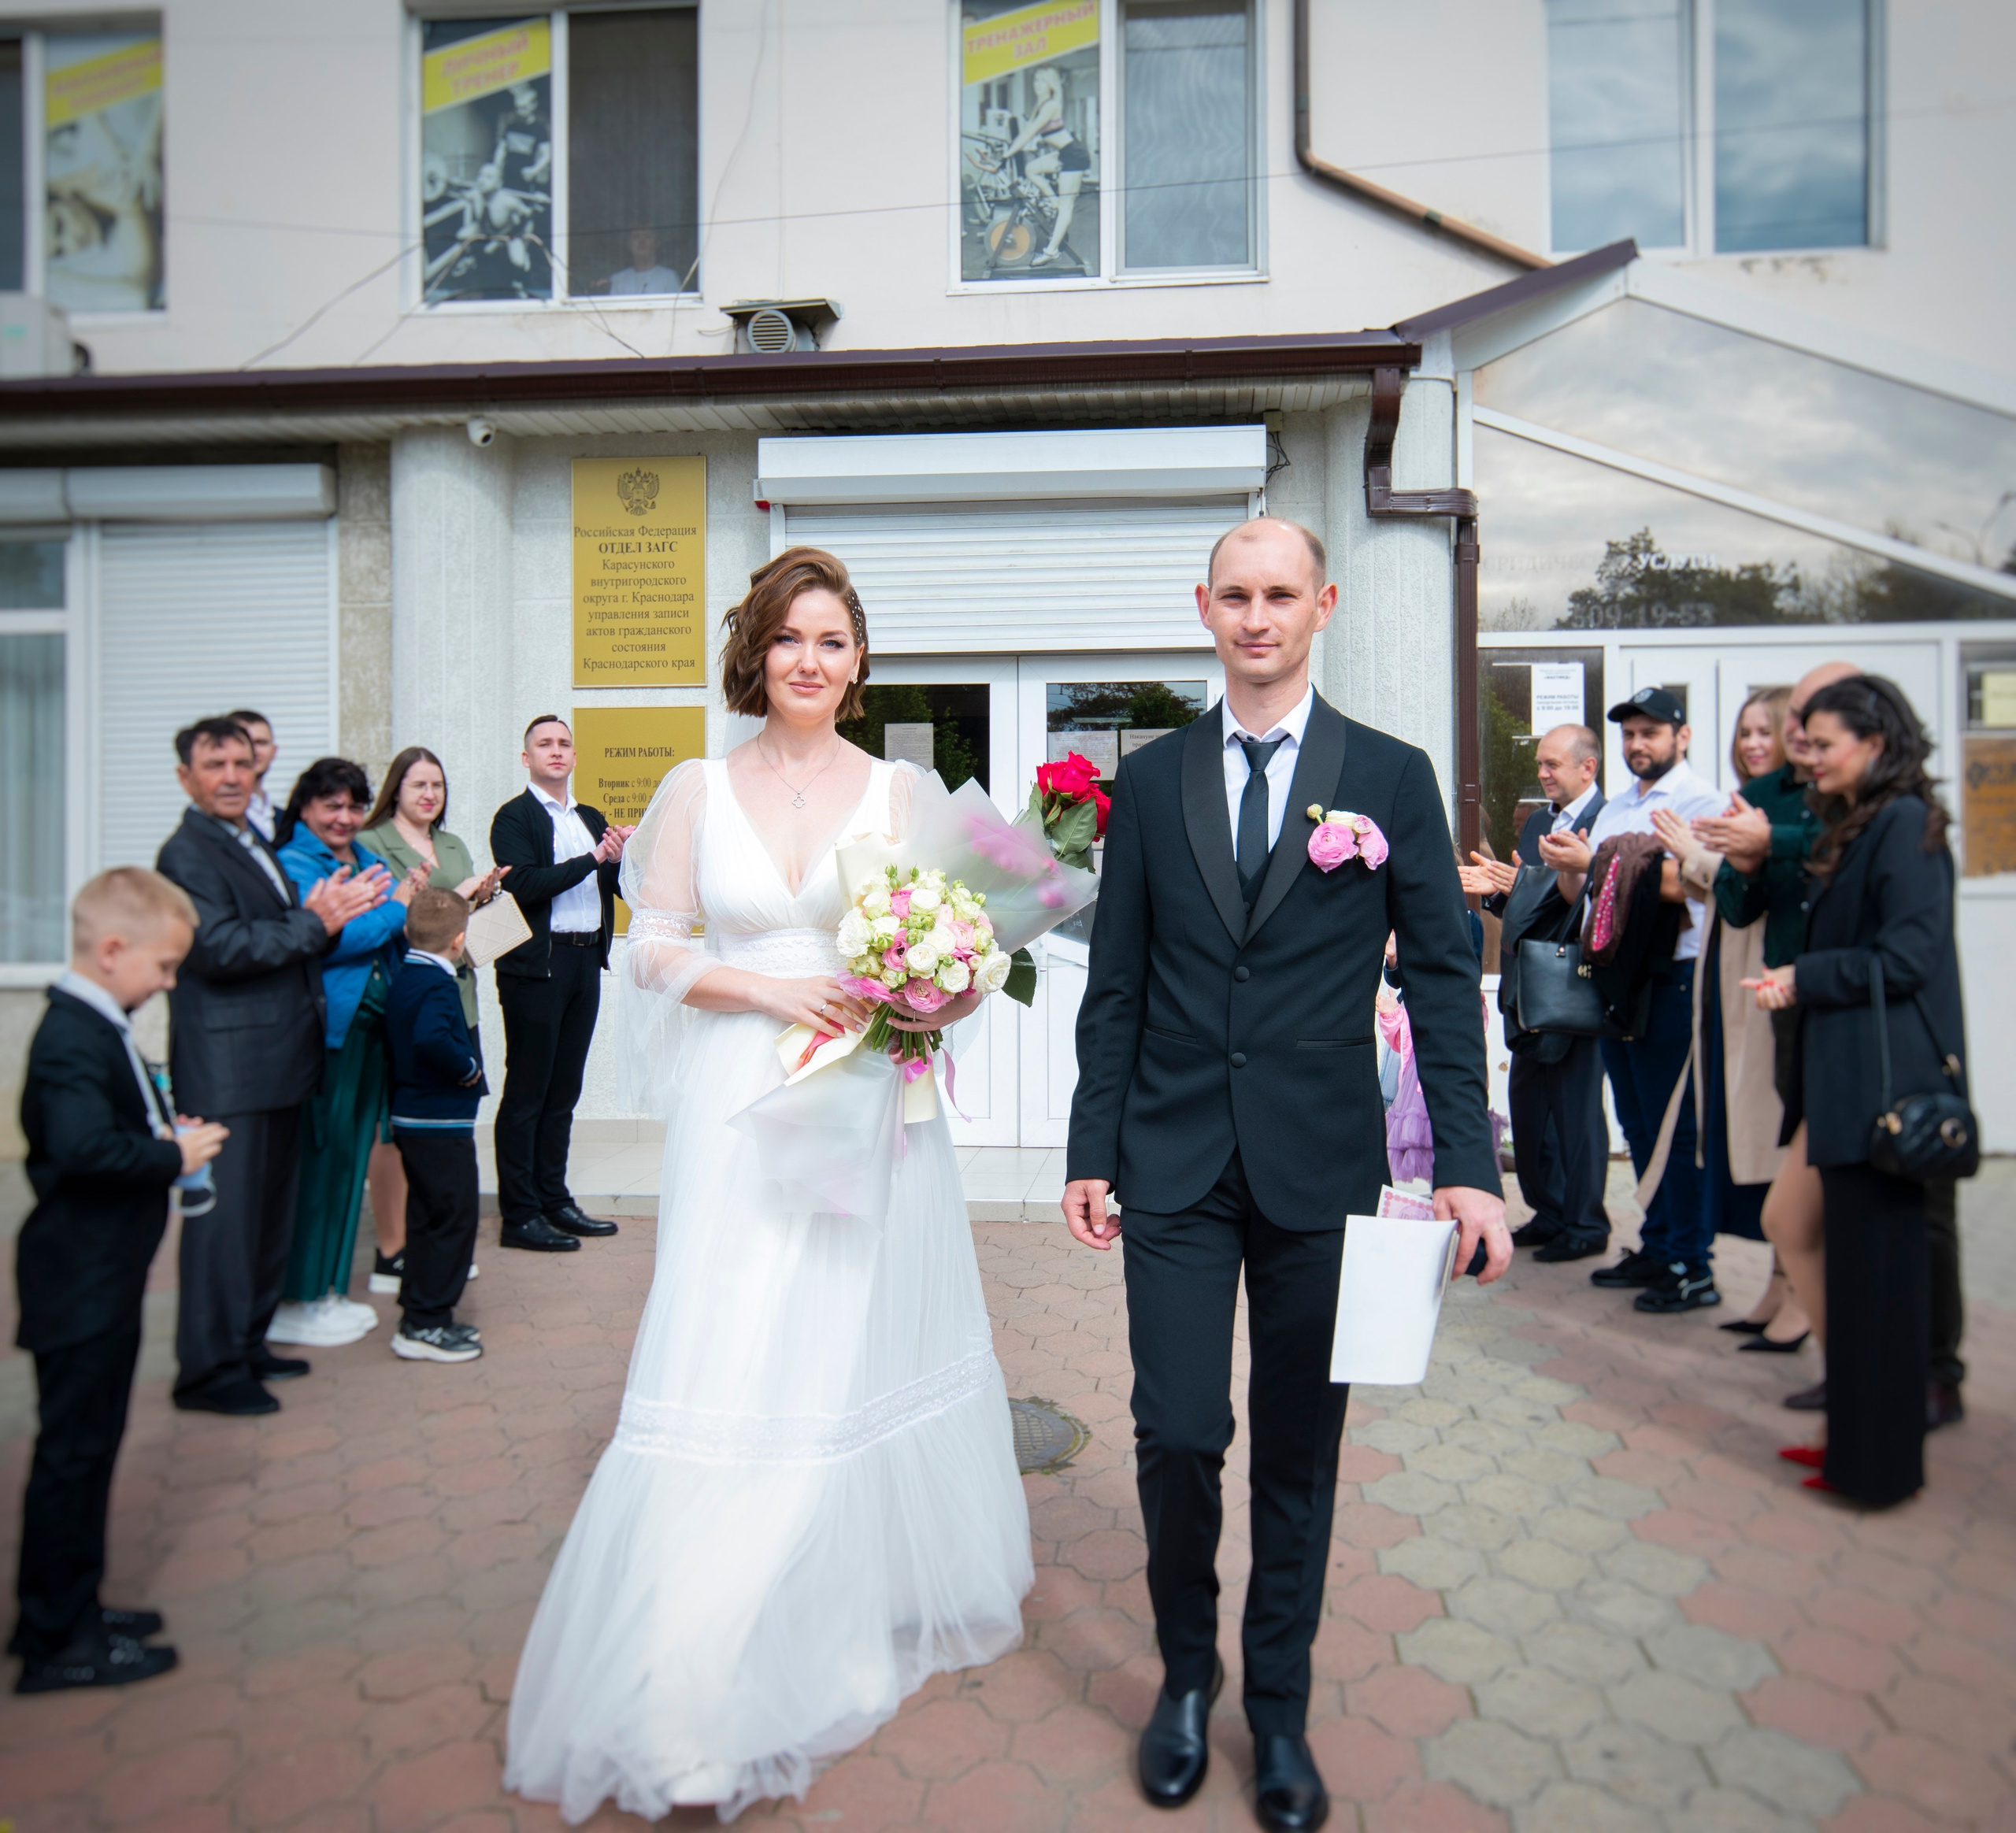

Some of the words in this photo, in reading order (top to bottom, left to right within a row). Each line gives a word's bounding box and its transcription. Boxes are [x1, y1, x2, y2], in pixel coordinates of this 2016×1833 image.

[1014, 35, 1047, 59] ЗАЛ
[574, 527, 635, 538] Российская
[638, 526, 697, 539] Федерация
[598, 542, 641, 554] ОТДЕЛ
[646, 541, 678, 553] ЗАГС
[602, 559, 675, 572] Карасунского
[591, 577, 687, 589] внутригородского
[583, 594, 618, 605] округа
[632, 591, 695, 605] Краснодара
[588, 611, 650, 622] управления
[653, 610, 689, 619] записи
[619, 626, 691, 639] гражданского
[612, 643, 665, 652] состояния
[584, 658, 668, 672] Краснодарского
[672, 659, 695, 670] края
[605, 747, 636, 757] РЕЖИМ
[638, 747, 675, 757] РАБОТЫ:
[598, 778, 629, 791] Вторник
[636, 777, 651, 788] 9:00
[603, 793, 624, 805] Среда
[632, 792, 647, 803] 9:00
[614, 808, 625, 818] НЕ
